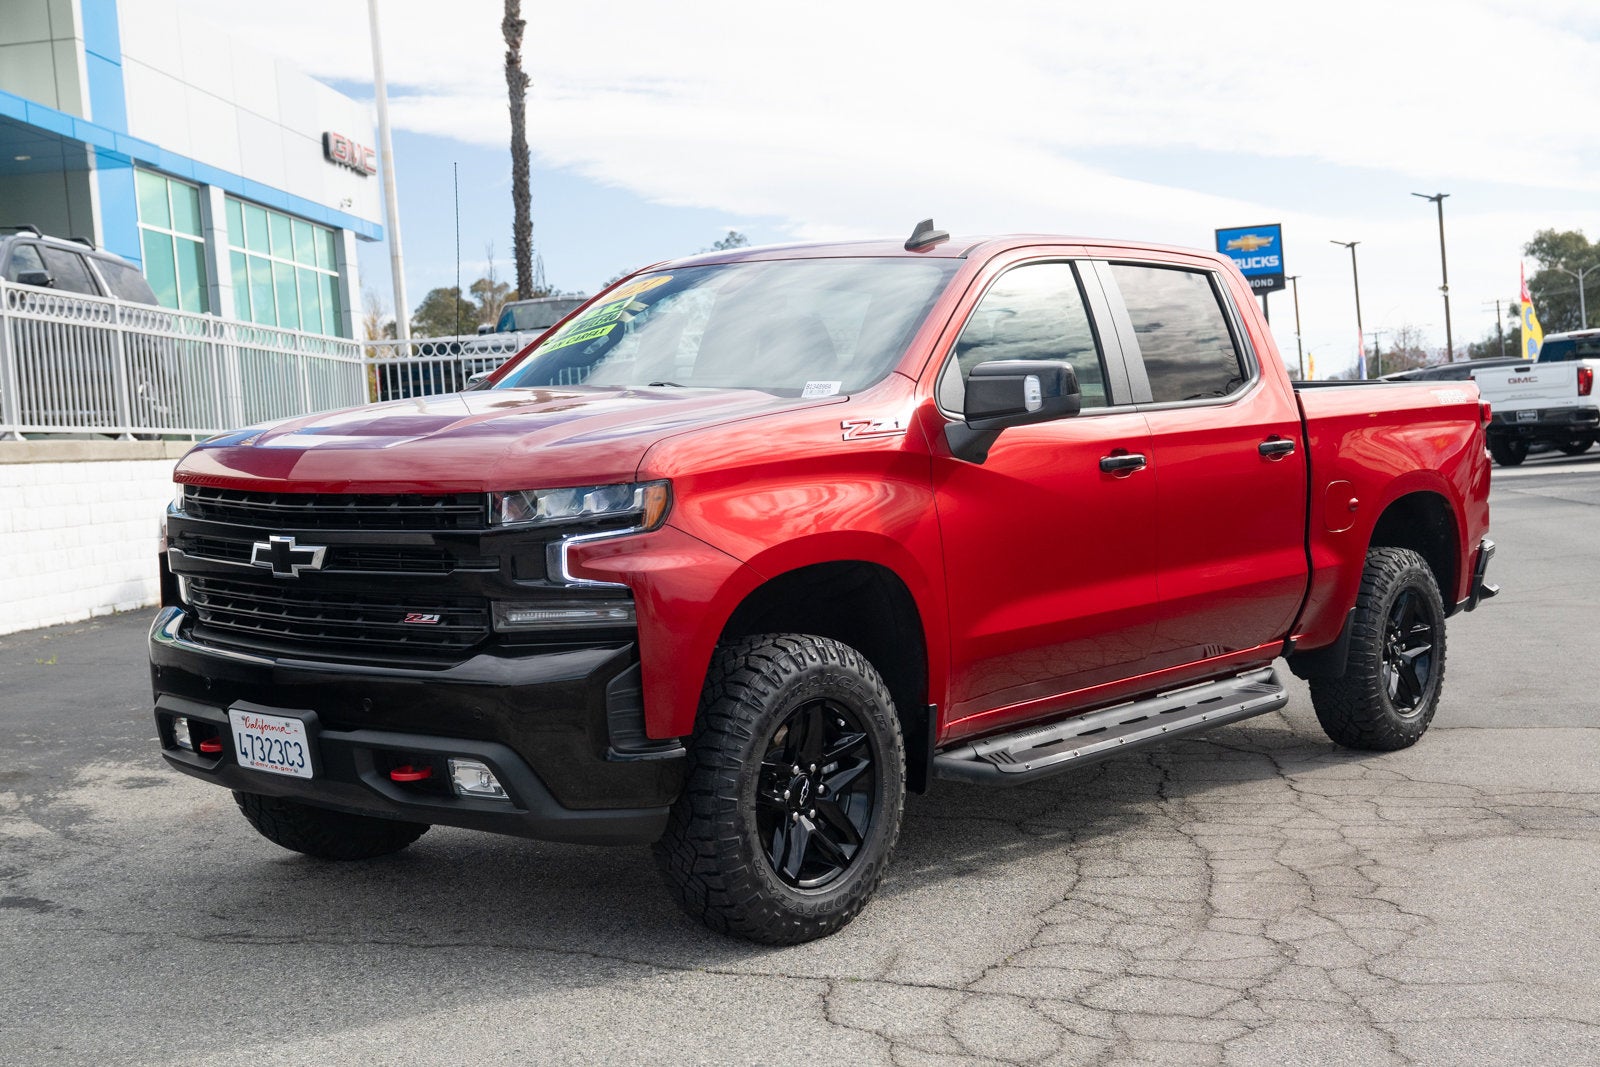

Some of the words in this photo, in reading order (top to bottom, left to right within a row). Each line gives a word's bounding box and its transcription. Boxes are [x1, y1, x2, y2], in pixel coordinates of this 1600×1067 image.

[330, 132, 377, 175] GMC
[1231, 255, 1280, 269] RUCKS
[1248, 278, 1274, 288] MOND
[566, 327, 607, 345] CARFAX
[1507, 376, 1538, 384] GMC
[403, 612, 441, 624] Z71
[244, 716, 292, 735] California
[238, 732, 305, 768] 47323C3
[753, 858, 875, 917] GOODYEAR
